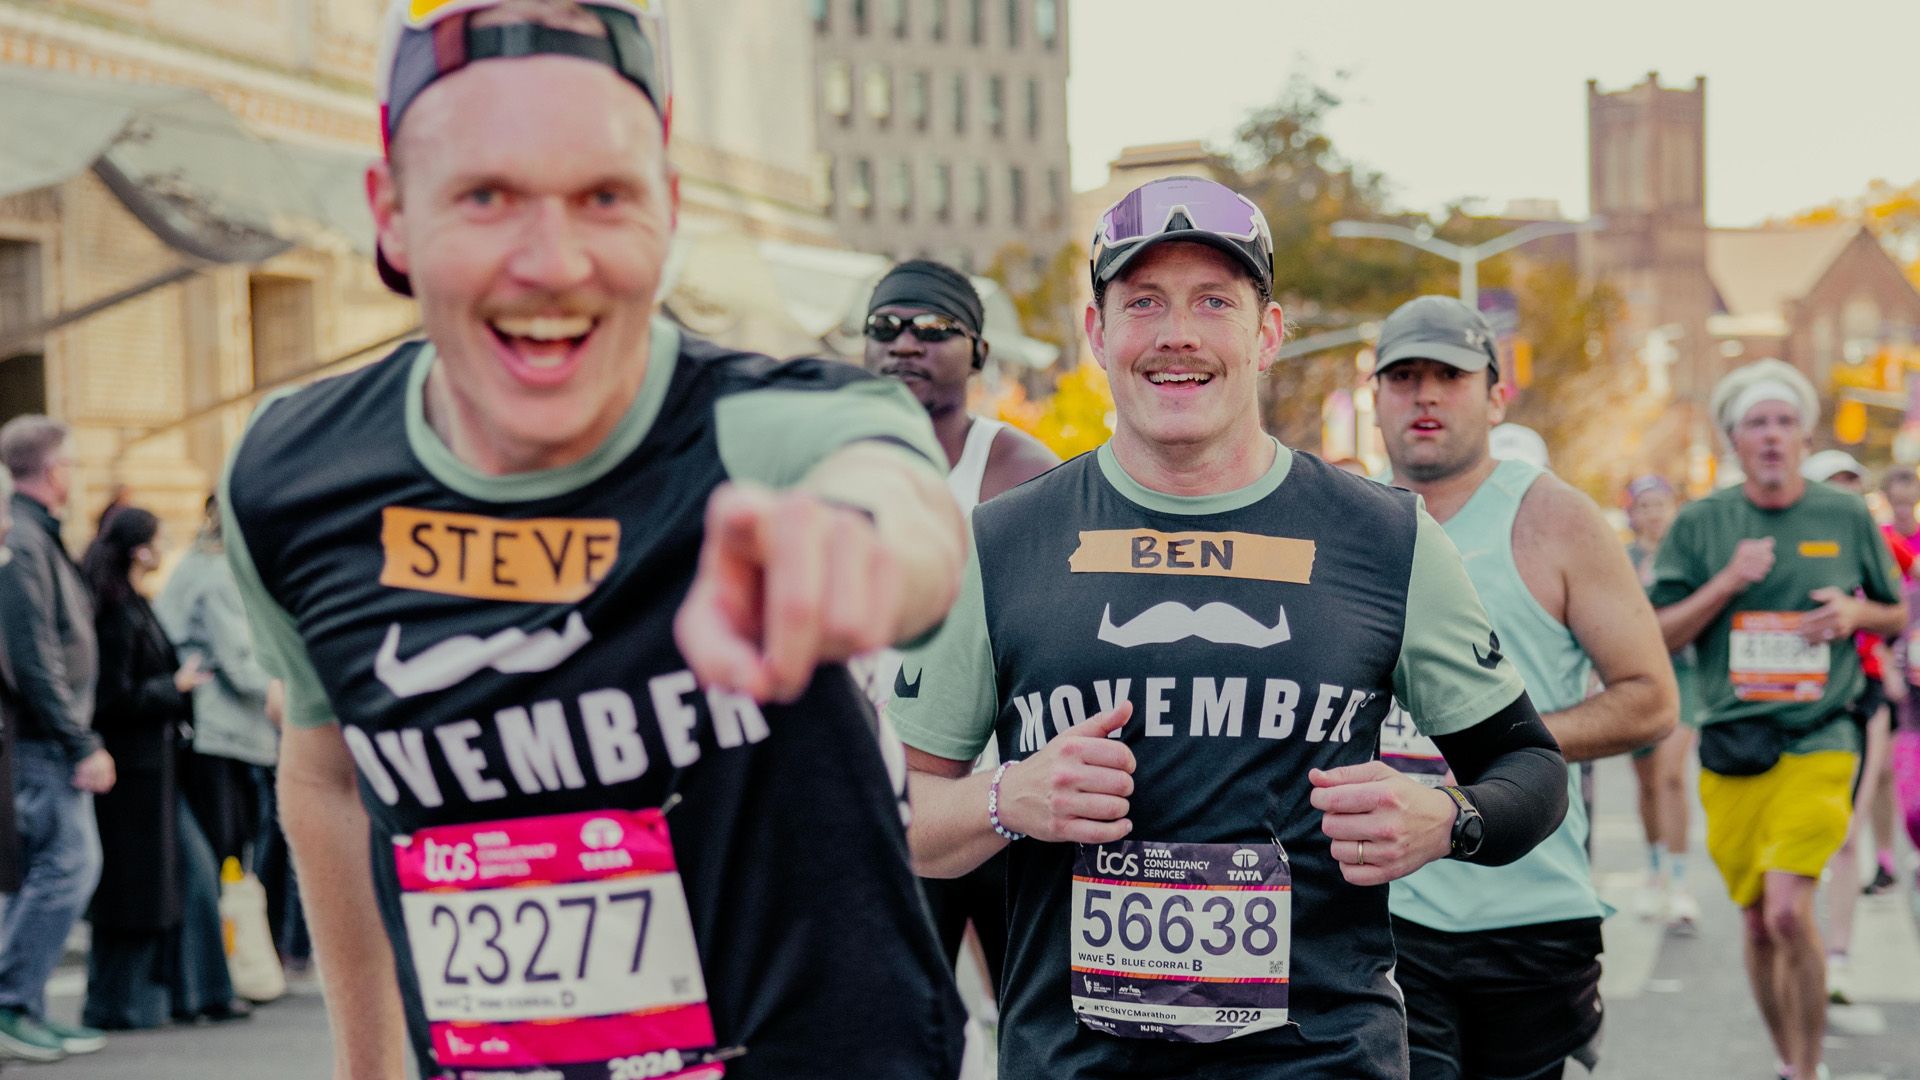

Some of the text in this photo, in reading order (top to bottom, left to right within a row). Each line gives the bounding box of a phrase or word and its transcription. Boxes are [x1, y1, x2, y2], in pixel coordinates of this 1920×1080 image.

[410, 522, 611, 587] STEVE
[1131, 536, 1234, 570] BEN
[1013, 677, 1367, 752] MOVEMBER
[1096, 844, 1139, 877] tcs
[1143, 848, 1172, 859] TATA
[1143, 859, 1210, 871] CONSULTANCY
[1143, 869, 1186, 880] SERVICES
[1227, 870, 1263, 881] TATA
[1082, 888, 1278, 957] 56638
[431, 889, 653, 985] 23277
[1077, 952, 1203, 972] WAVE 5 BLUE CORRAL B
[1093, 1004, 1261, 1023] #TCSNYCMarathon 2024
